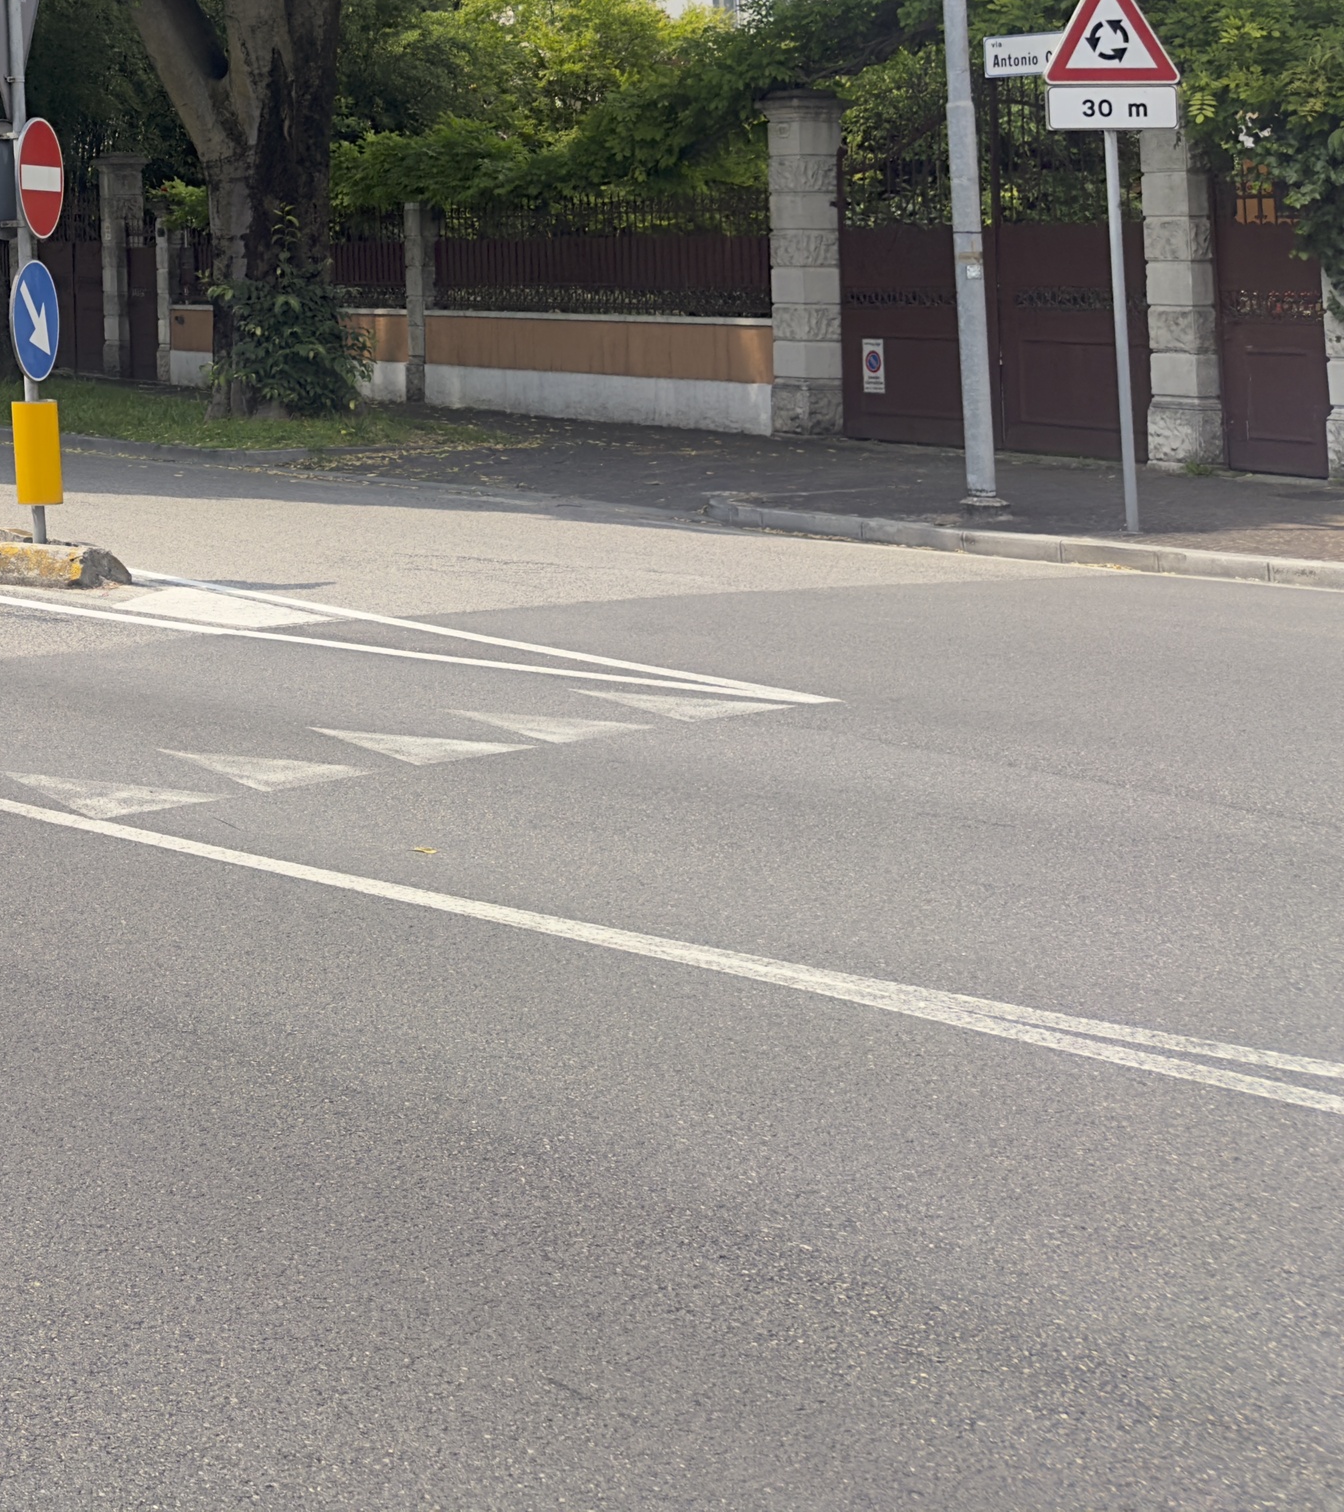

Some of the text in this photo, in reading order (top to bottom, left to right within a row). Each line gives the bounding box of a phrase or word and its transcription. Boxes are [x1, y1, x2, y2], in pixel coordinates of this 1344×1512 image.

[992, 52, 1039, 68] Antonio
[1082, 99, 1148, 118] 30 m
